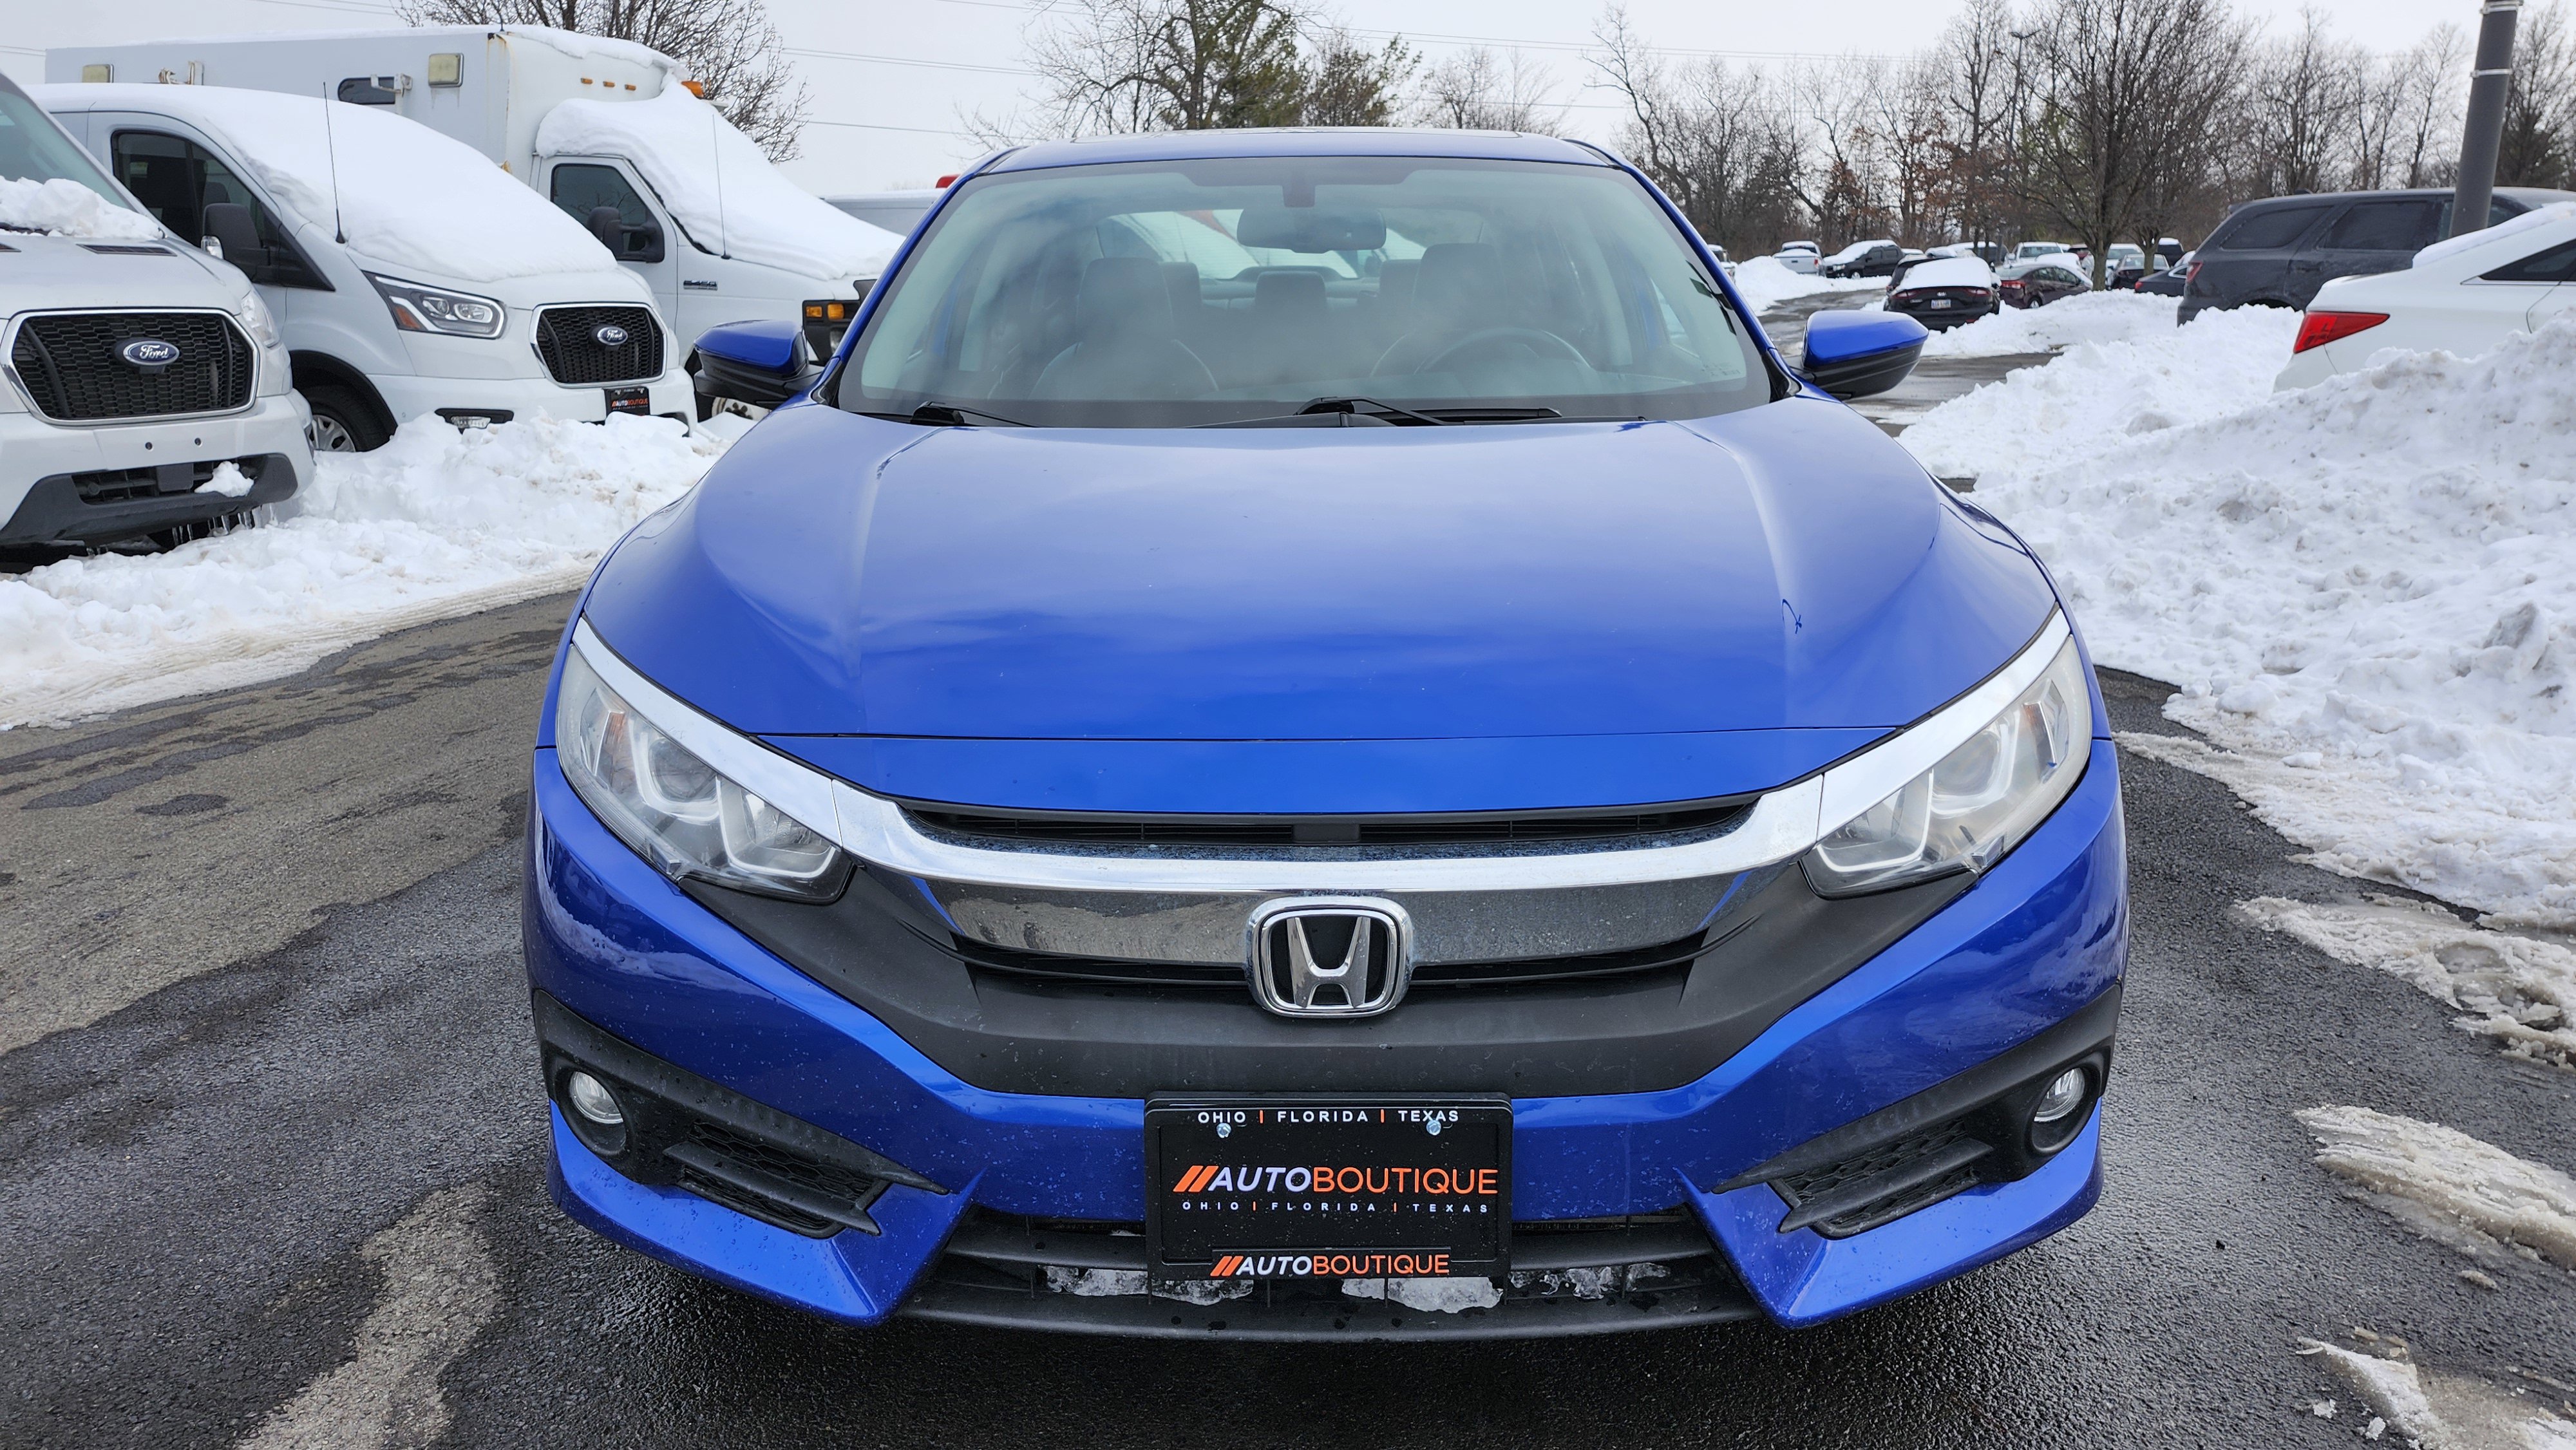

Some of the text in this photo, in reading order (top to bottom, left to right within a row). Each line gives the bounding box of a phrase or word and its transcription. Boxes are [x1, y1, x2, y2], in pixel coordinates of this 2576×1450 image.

[139, 344, 169, 359] Ford
[1198, 1110, 1459, 1124] OHIO FLORIDA TEXAS
[1208, 1167, 1499, 1194] AUTOBOUTIQUE
[1182, 1201, 1488, 1213] OHIO FLORIDA TEXAS
[1236, 1254, 1450, 1276] AUTOBOUTIQUE
